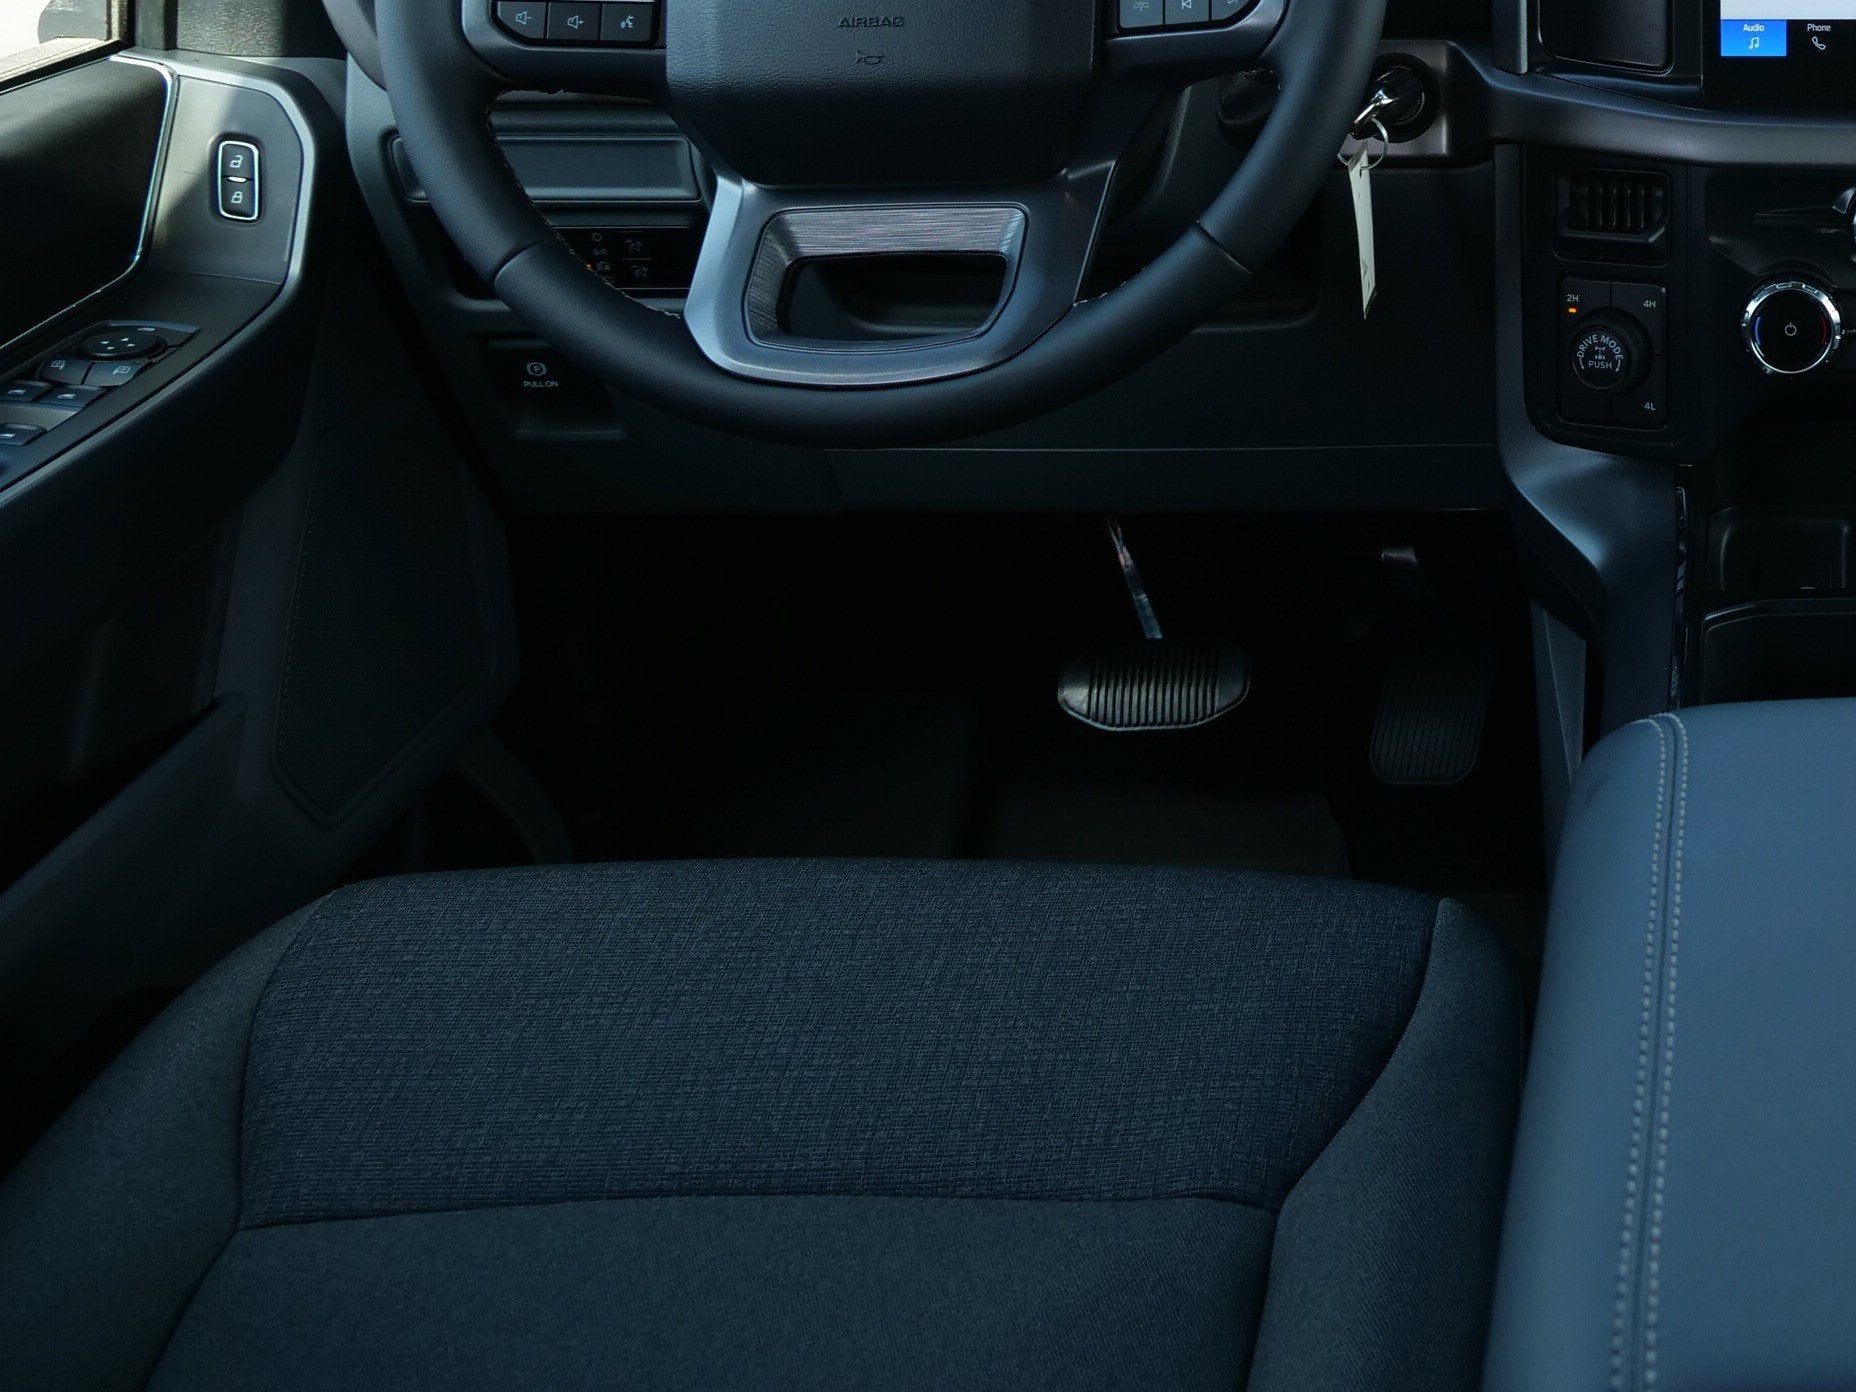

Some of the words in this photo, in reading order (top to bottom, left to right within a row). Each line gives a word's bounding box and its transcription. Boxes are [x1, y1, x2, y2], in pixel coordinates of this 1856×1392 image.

[838, 16, 905, 29] AIRBAG
[1742, 23, 1765, 33] Audio
[1807, 23, 1832, 33] Phone
[1566, 294, 1579, 303] 2H
[1642, 299, 1657, 309] 4H
[1576, 333, 1599, 359] DRIVE
[1600, 334, 1624, 360] MODE
[1588, 360, 1613, 370] PUSH
[523, 380, 546, 388] PULL
[1643, 402, 1656, 411] 4L
